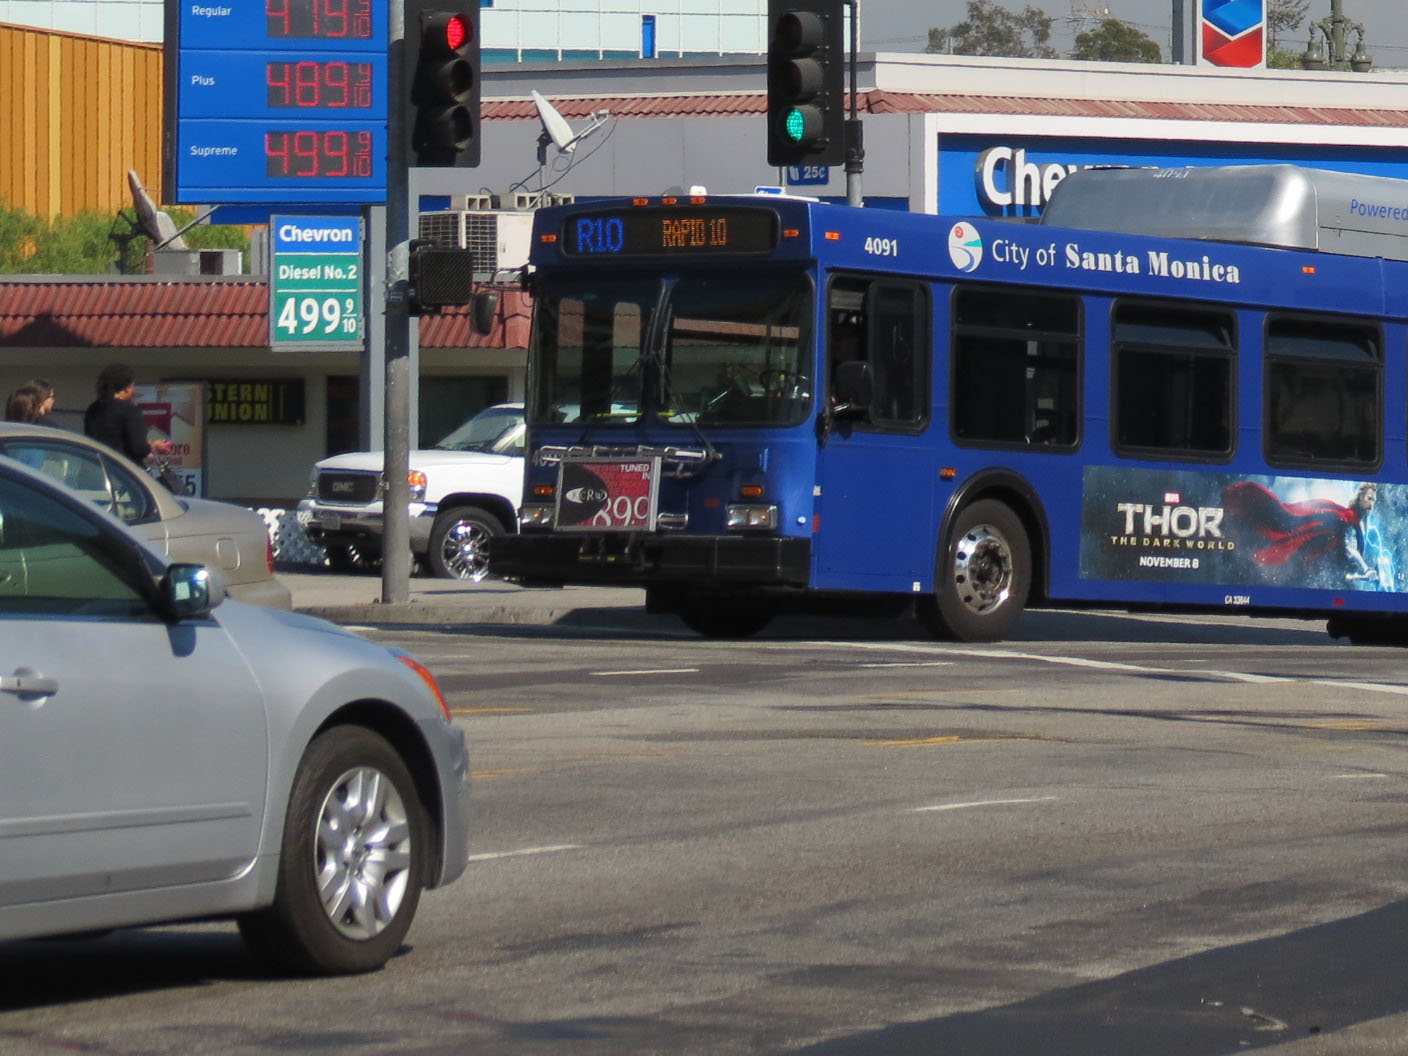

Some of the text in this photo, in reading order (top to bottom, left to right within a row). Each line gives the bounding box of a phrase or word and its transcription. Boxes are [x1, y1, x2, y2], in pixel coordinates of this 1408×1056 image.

[192, 5, 232, 17] Regular
[191, 75, 215, 87] Plus
[265, 61, 349, 107] 489
[190, 144, 238, 157] Supreme
[264, 131, 349, 177] 499
[279, 224, 353, 242] Chevron
[577, 218, 624, 252] R10
[662, 219, 728, 247] RAPID 10
[864, 237, 898, 257] 4091
[992, 240, 1241, 284] City of Santa Monica
[279, 265, 321, 280] Diesel
[277, 297, 341, 335] 499
[620, 463, 650, 473] TUNED
[1117, 503, 1225, 538] THOR
[1111, 536, 1235, 550] THE DARK WORLD
[1140, 556, 1199, 569] NOVEMBER 8
